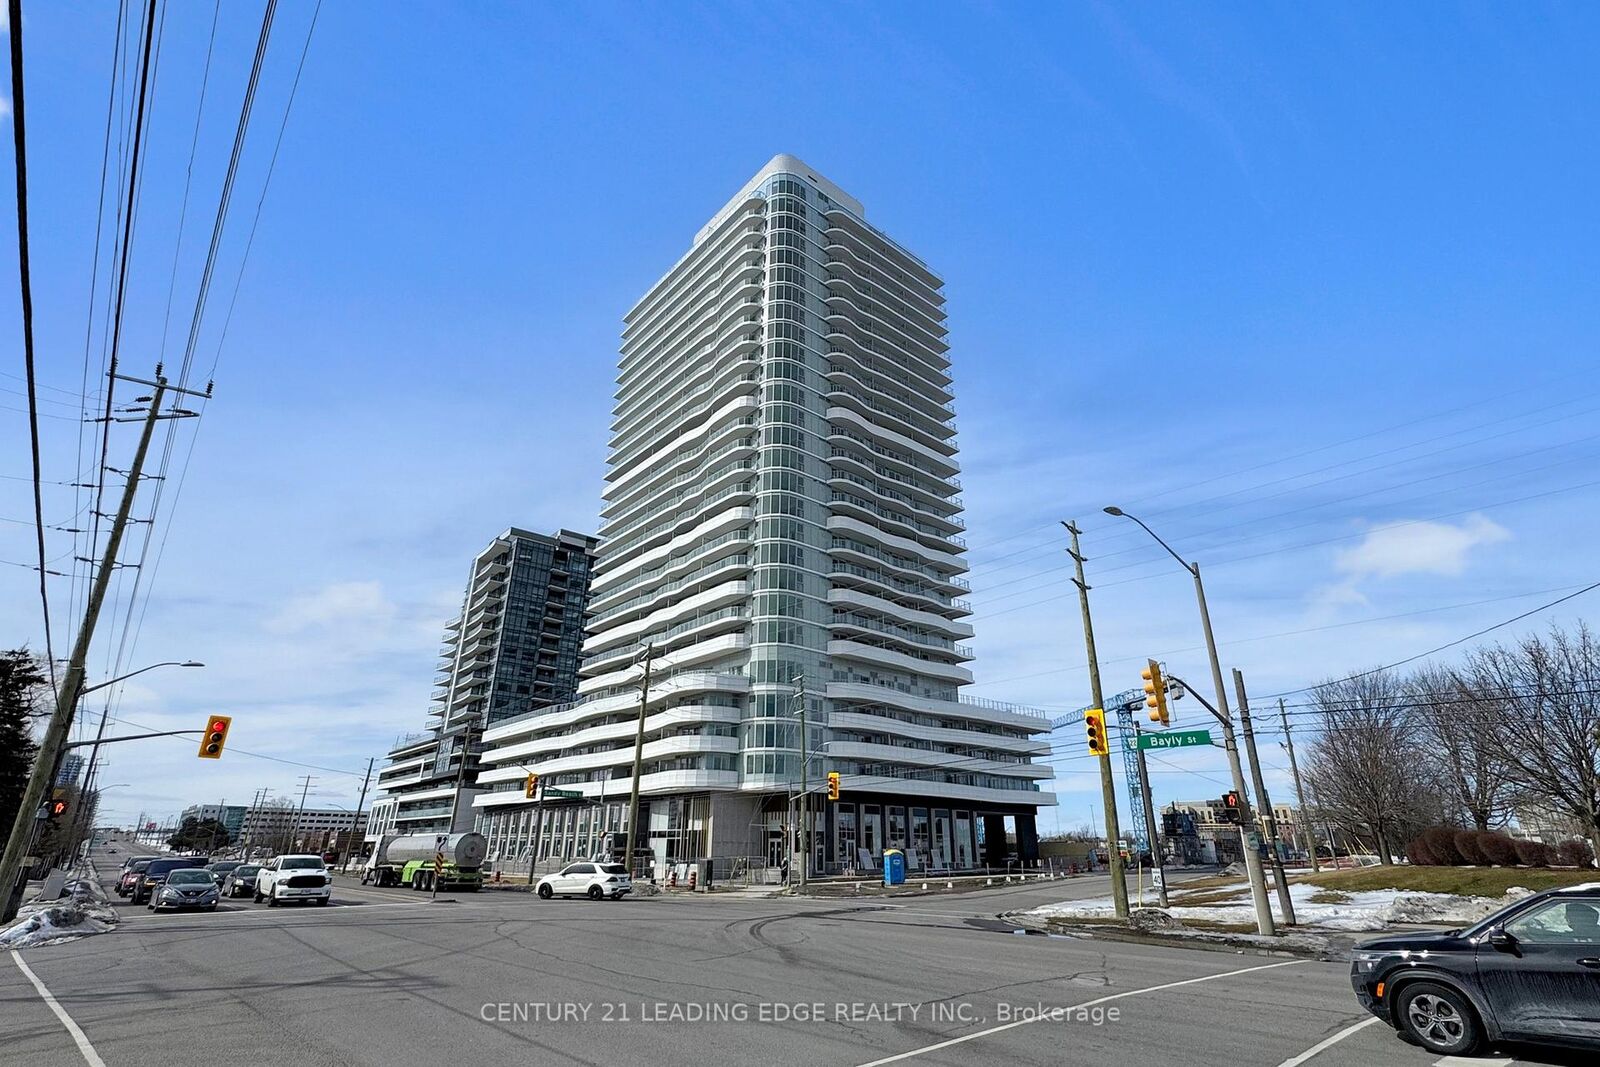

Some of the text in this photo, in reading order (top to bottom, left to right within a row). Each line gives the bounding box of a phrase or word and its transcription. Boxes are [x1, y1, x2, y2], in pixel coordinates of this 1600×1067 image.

[1150, 736, 1197, 747] Bayly St
[1154, 875, 1161, 885] 40
